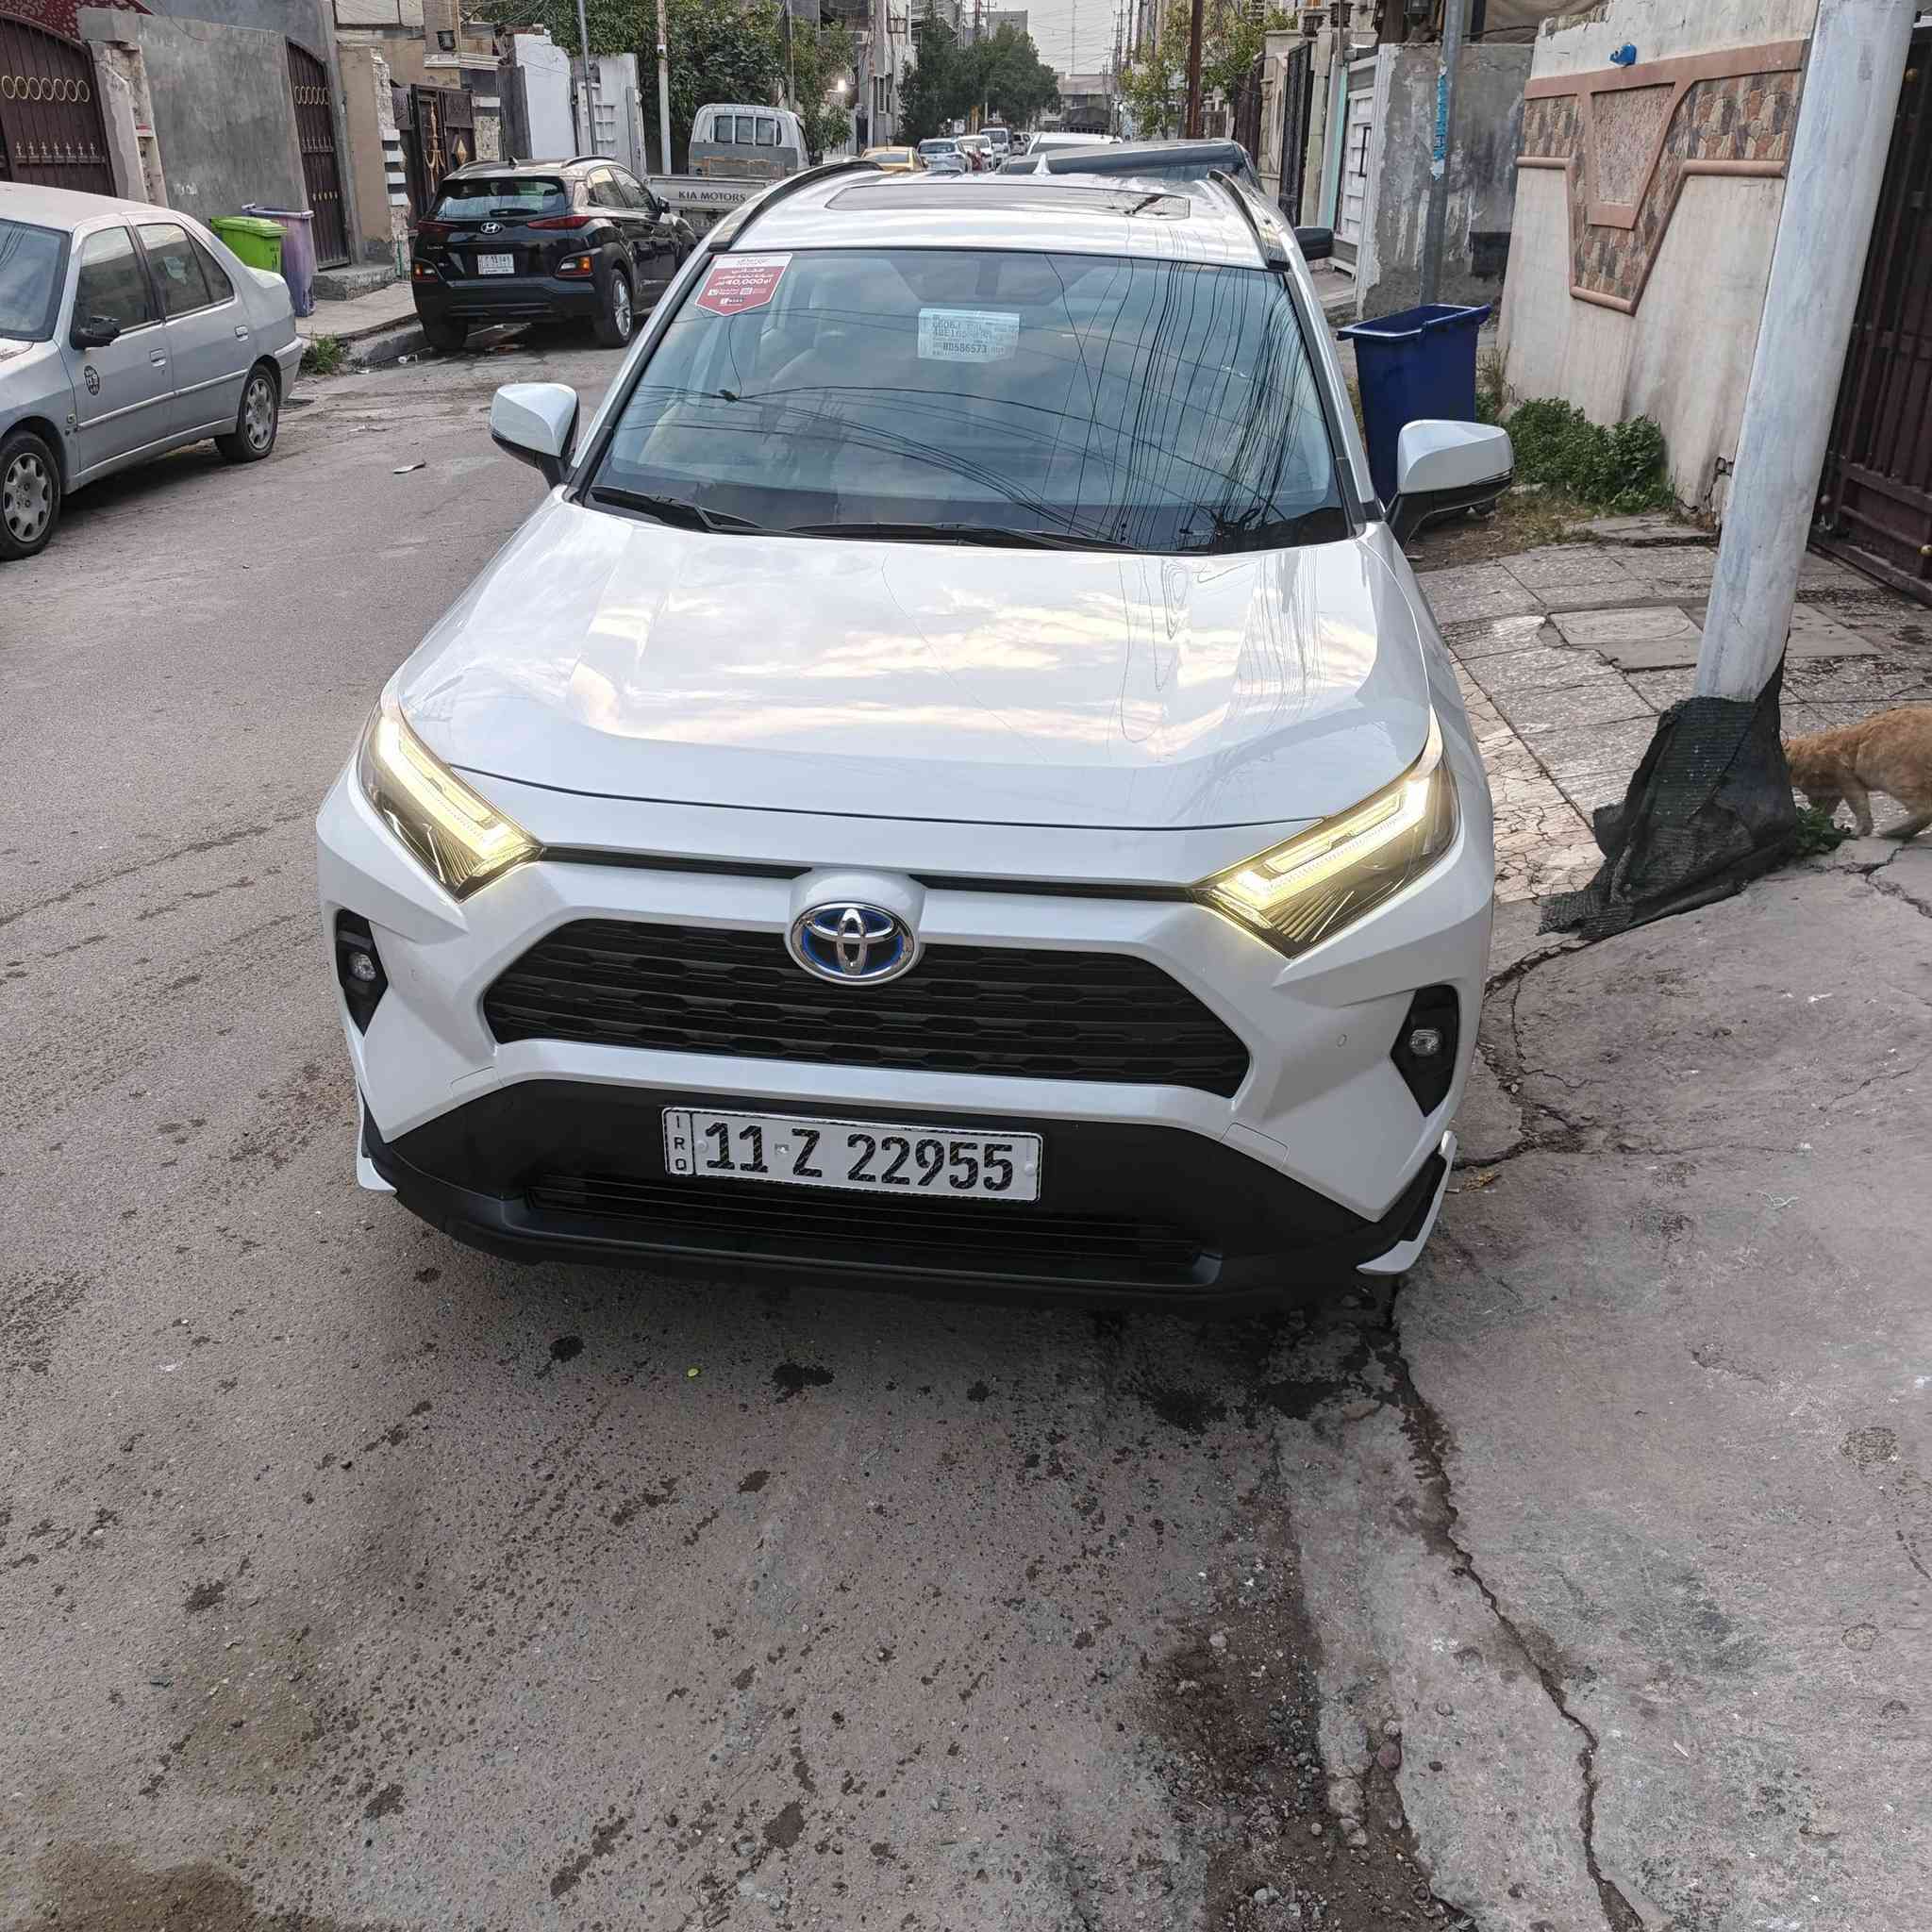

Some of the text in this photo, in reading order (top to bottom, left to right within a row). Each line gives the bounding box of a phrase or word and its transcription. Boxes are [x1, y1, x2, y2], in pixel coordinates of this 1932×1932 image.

[678, 191, 746, 202] KIA MOTORS
[705, 1122, 1014, 1191] 11 Z 22955
